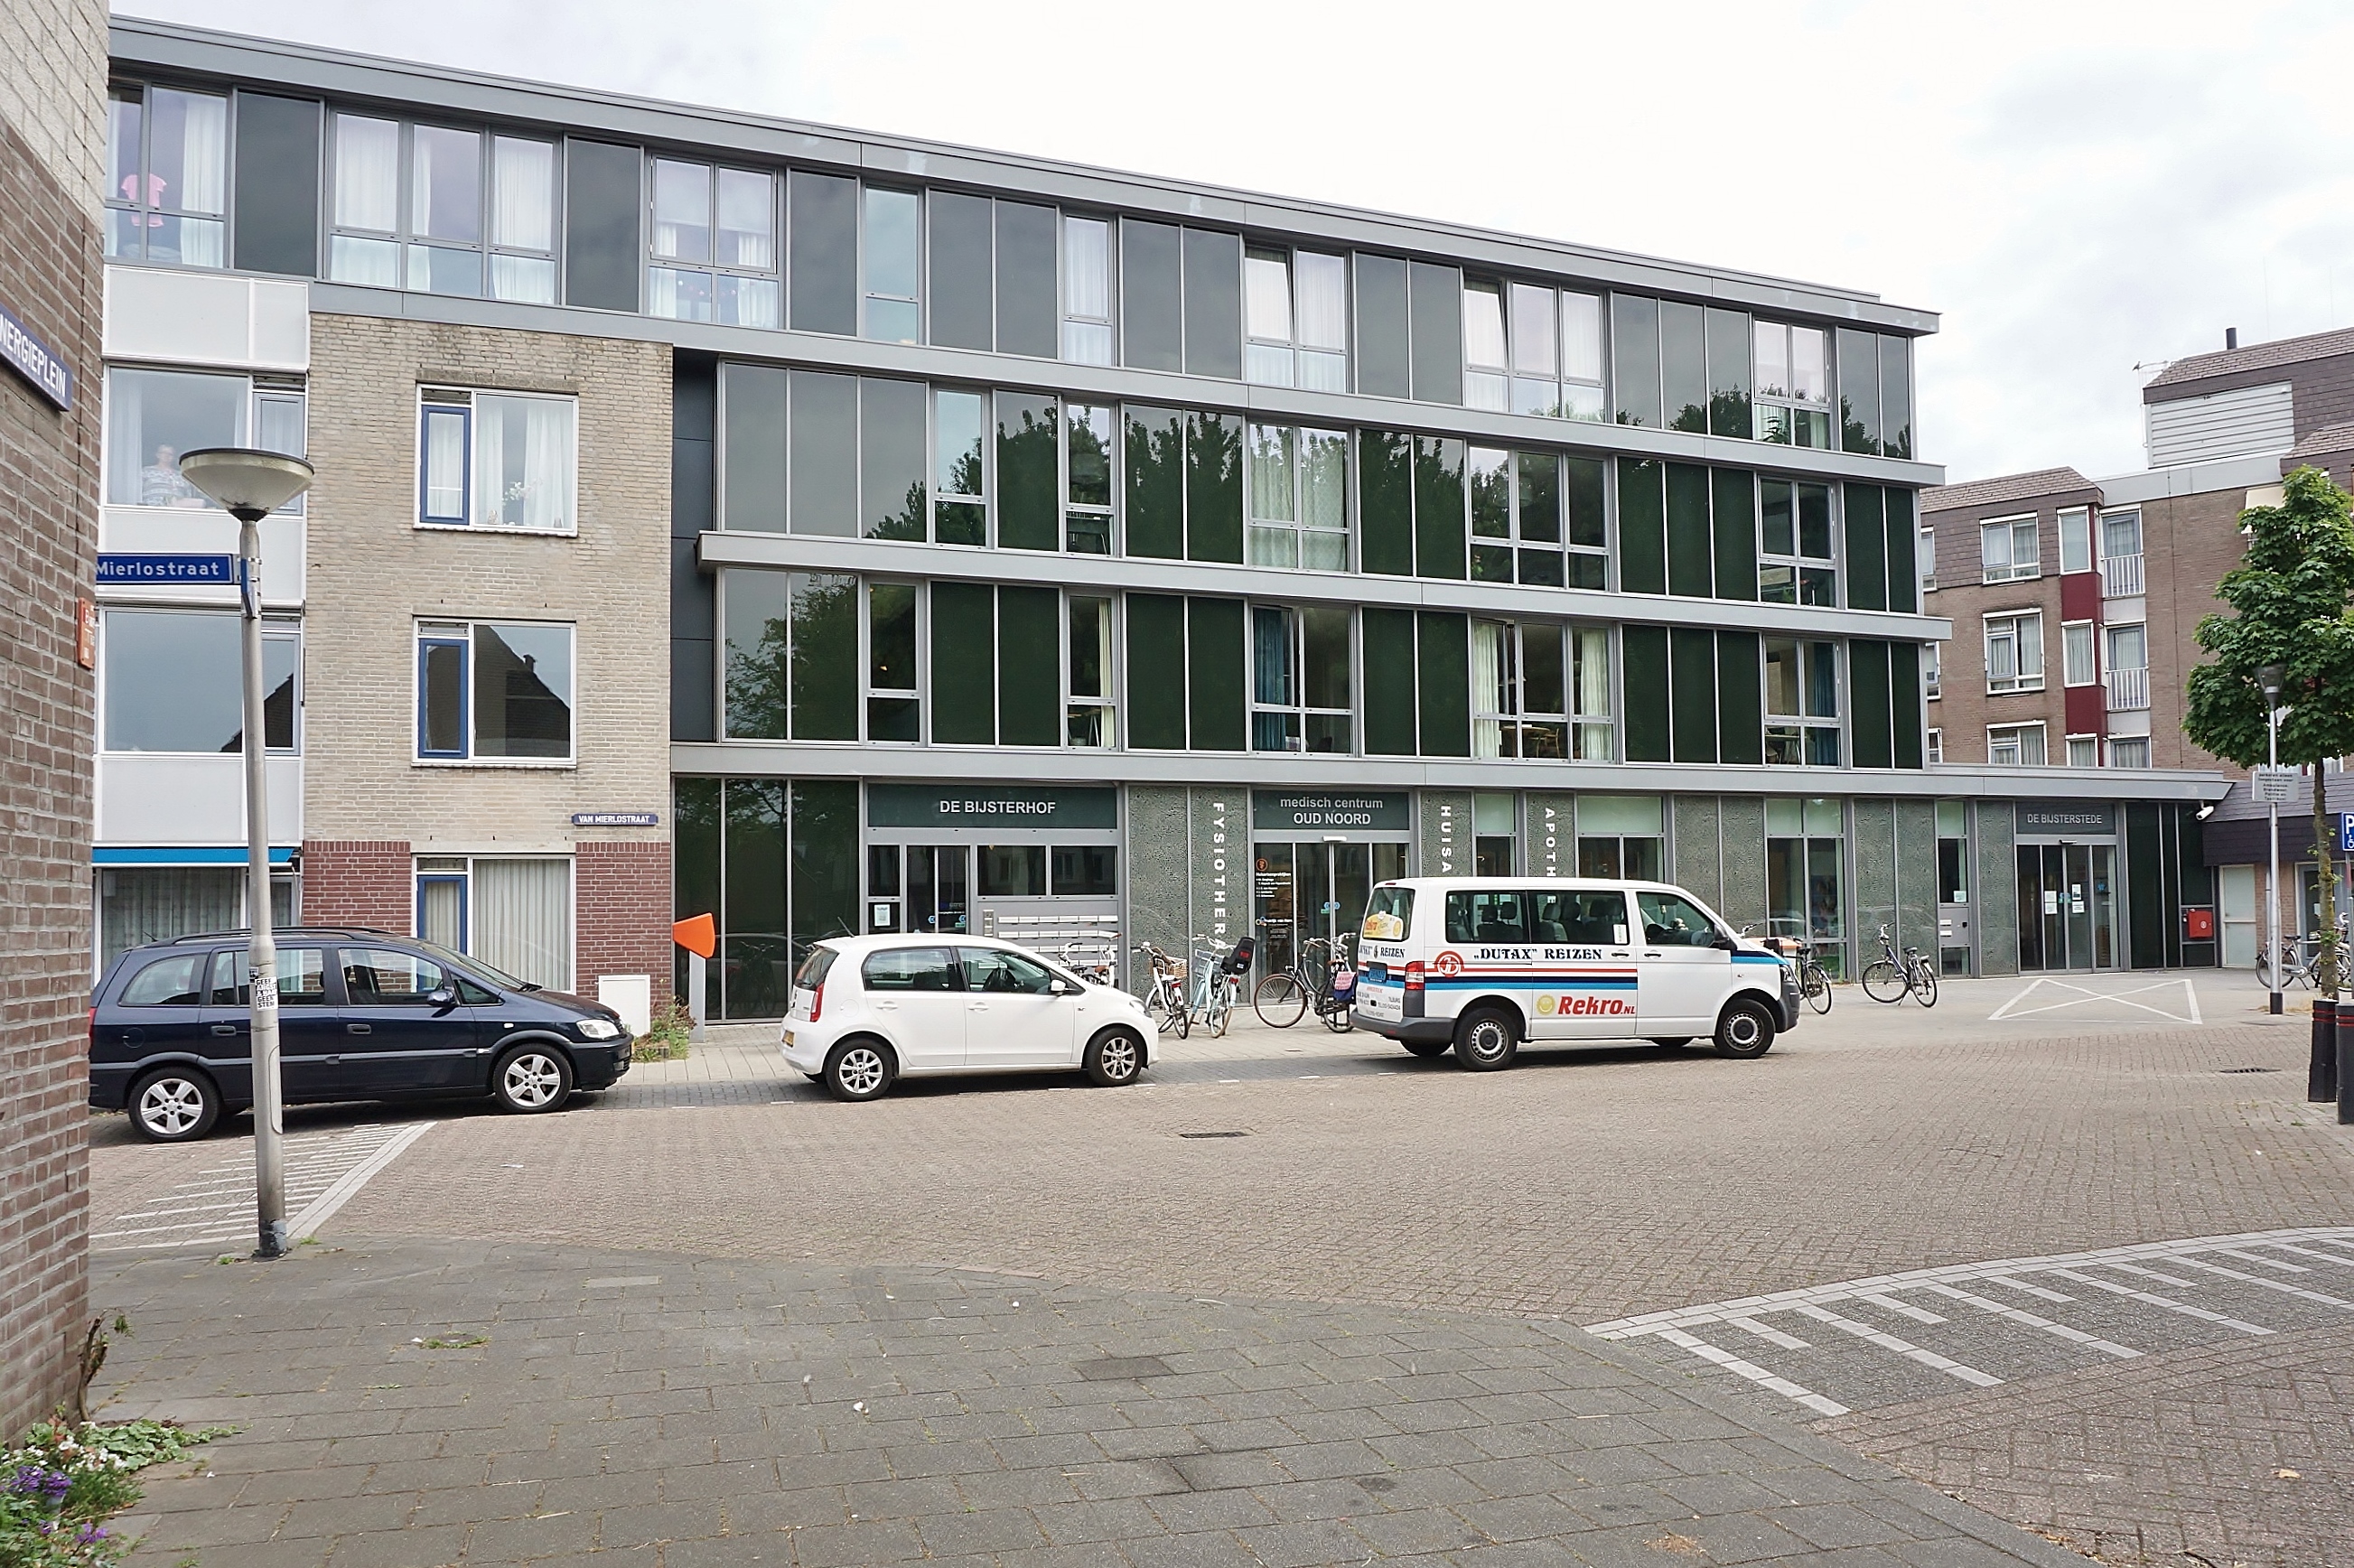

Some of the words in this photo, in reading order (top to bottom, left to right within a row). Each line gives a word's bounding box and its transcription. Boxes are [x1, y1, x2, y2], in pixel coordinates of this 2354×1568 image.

[96, 561, 220, 576] Mierlostraat
[939, 800, 961, 813] DE
[964, 801, 1056, 814] BIJSTERHOF
[1280, 797, 1331, 808] medisch
[1334, 798, 1383, 809] centrum
[578, 815, 593, 824] VAN
[594, 815, 650, 824] MIERLOSTRAAT
[1294, 813, 1322, 825] OUD
[1325, 813, 1371, 825] NOORD
[2027, 814, 2040, 824] DE
[2041, 814, 2103, 824] BIJSTERSTEDE
[1380, 947, 1406, 958] REIZEN
[1545, 948, 1602, 960] REIZEN
